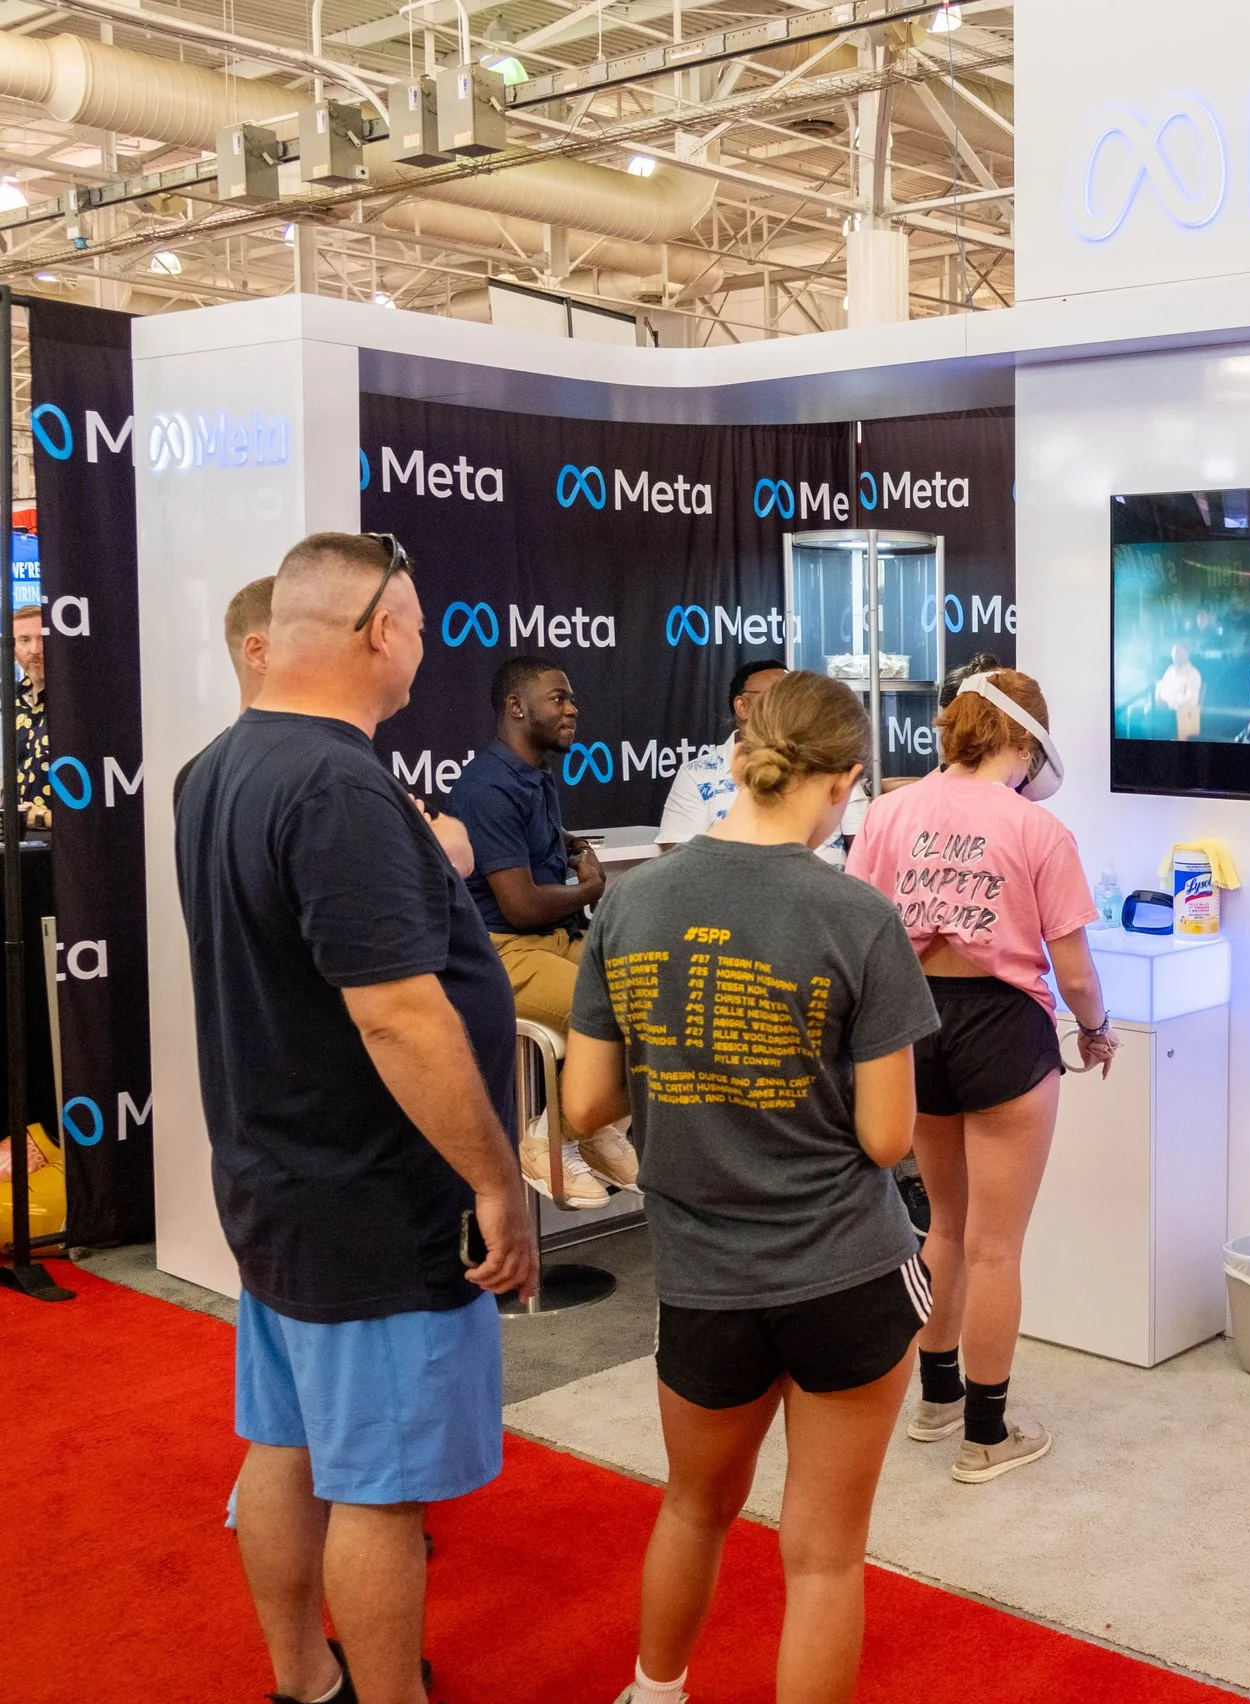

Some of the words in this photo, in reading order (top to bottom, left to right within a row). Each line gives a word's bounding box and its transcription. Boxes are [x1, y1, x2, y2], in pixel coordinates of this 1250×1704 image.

[193, 410, 290, 469] Meta
[381, 446, 504, 502] Meta
[614, 469, 713, 515] Meta
[883, 471, 970, 509] Meta
[509, 604, 616, 648] Meta
[911, 830, 986, 864] CLIMB
[897, 867, 1005, 900] OMPETE
[684, 927, 731, 946] #SPP
[897, 897, 997, 937] ONQUER
